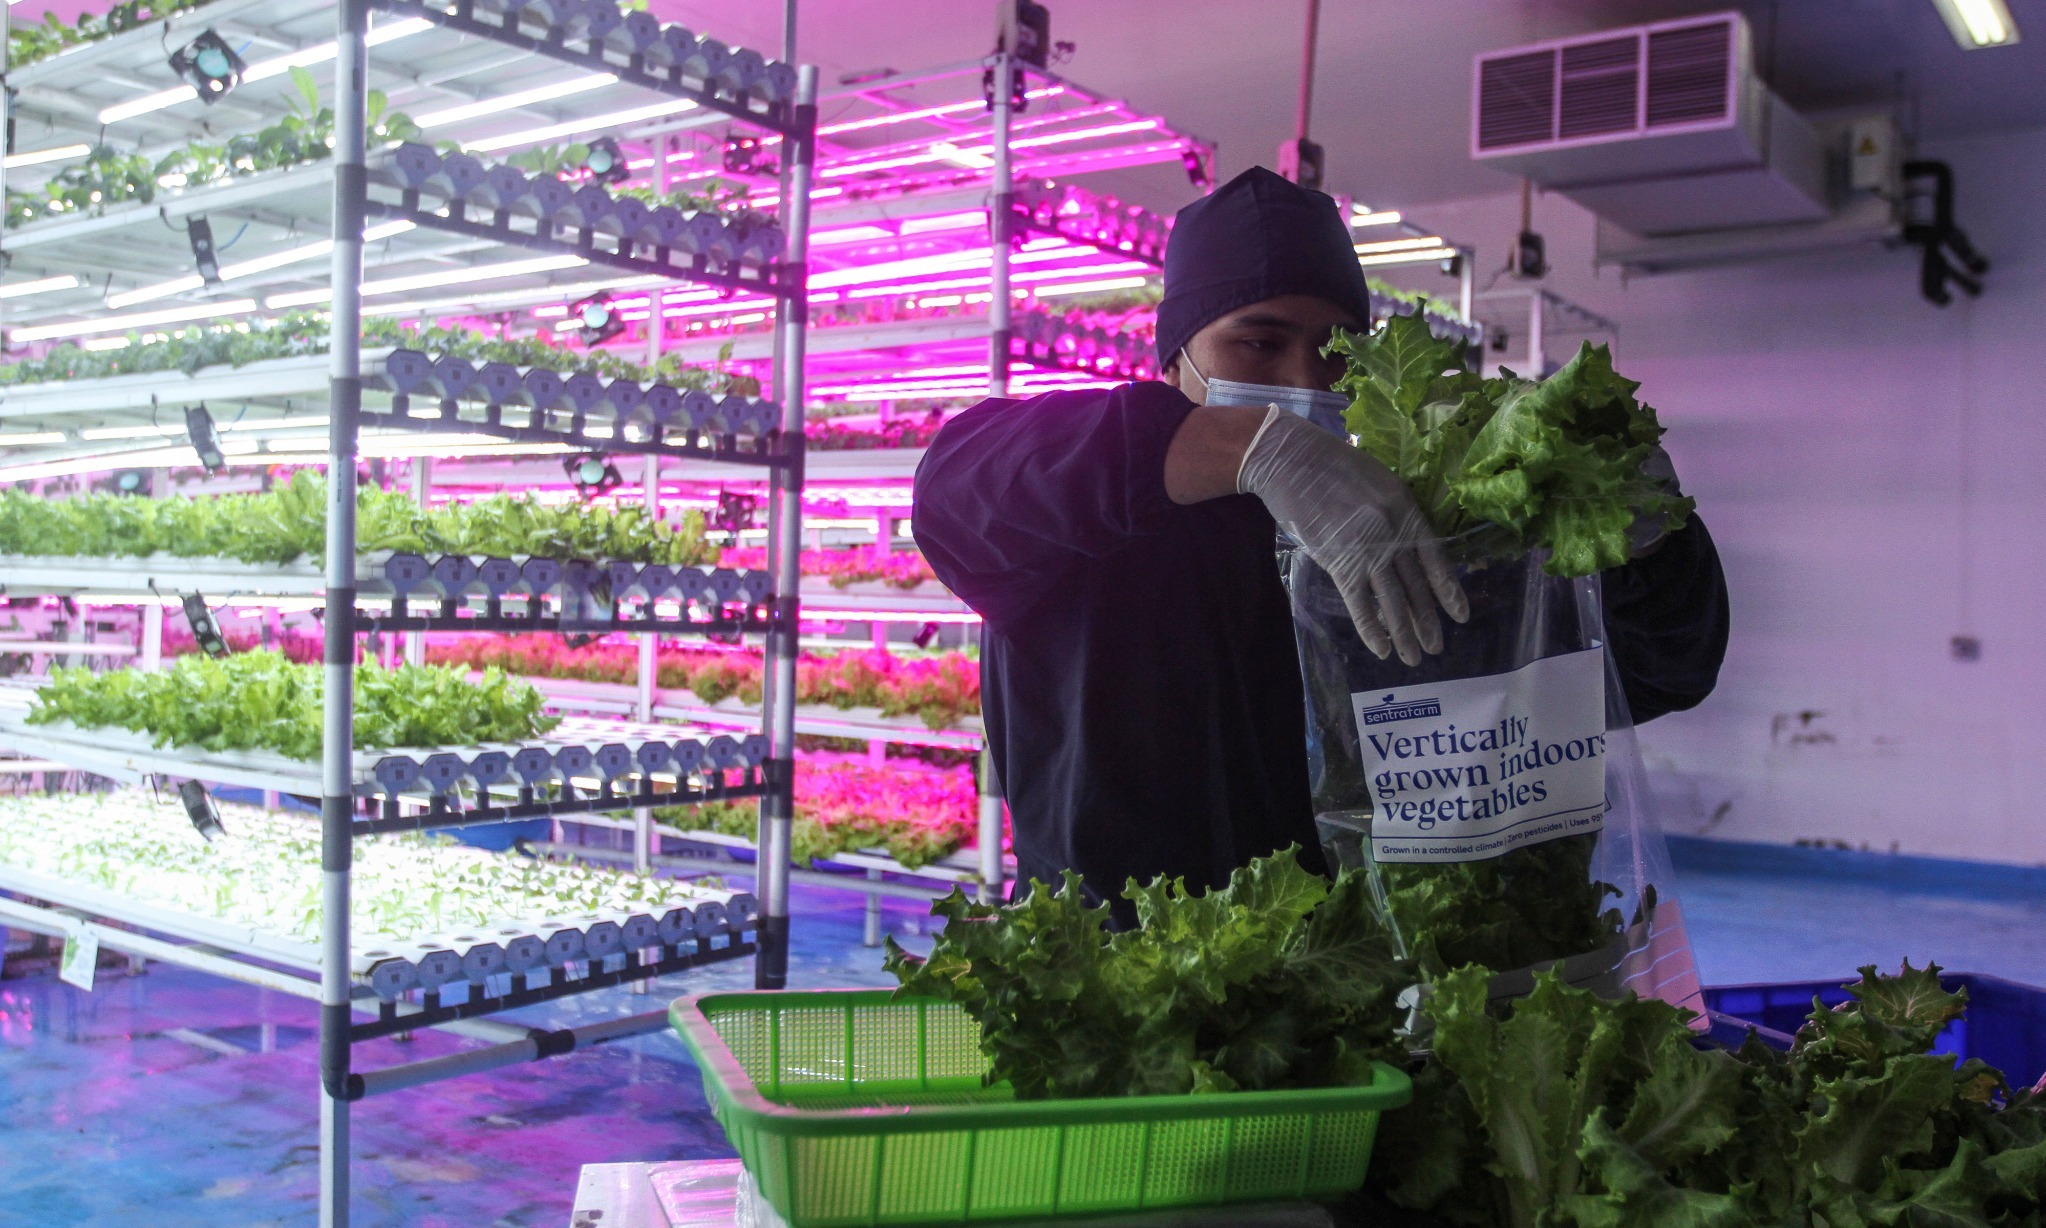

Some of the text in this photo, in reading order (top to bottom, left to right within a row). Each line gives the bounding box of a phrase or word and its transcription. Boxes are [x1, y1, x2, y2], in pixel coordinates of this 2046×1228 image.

[1367, 704, 1438, 723] sentrafarm
[1367, 715, 1529, 761] Vertically
[1375, 763, 1490, 799] grown
[1381, 780, 1548, 831] vegetables
[1382, 845, 1410, 854] Grown
[1412, 845, 1420, 854] in
[1429, 845, 1473, 854] controlled
[1475, 840, 1504, 852] climate
[1508, 833, 1523, 843] Zero
[1524, 823, 1563, 839] pesticides
[1569, 818, 1590, 827] Uses
